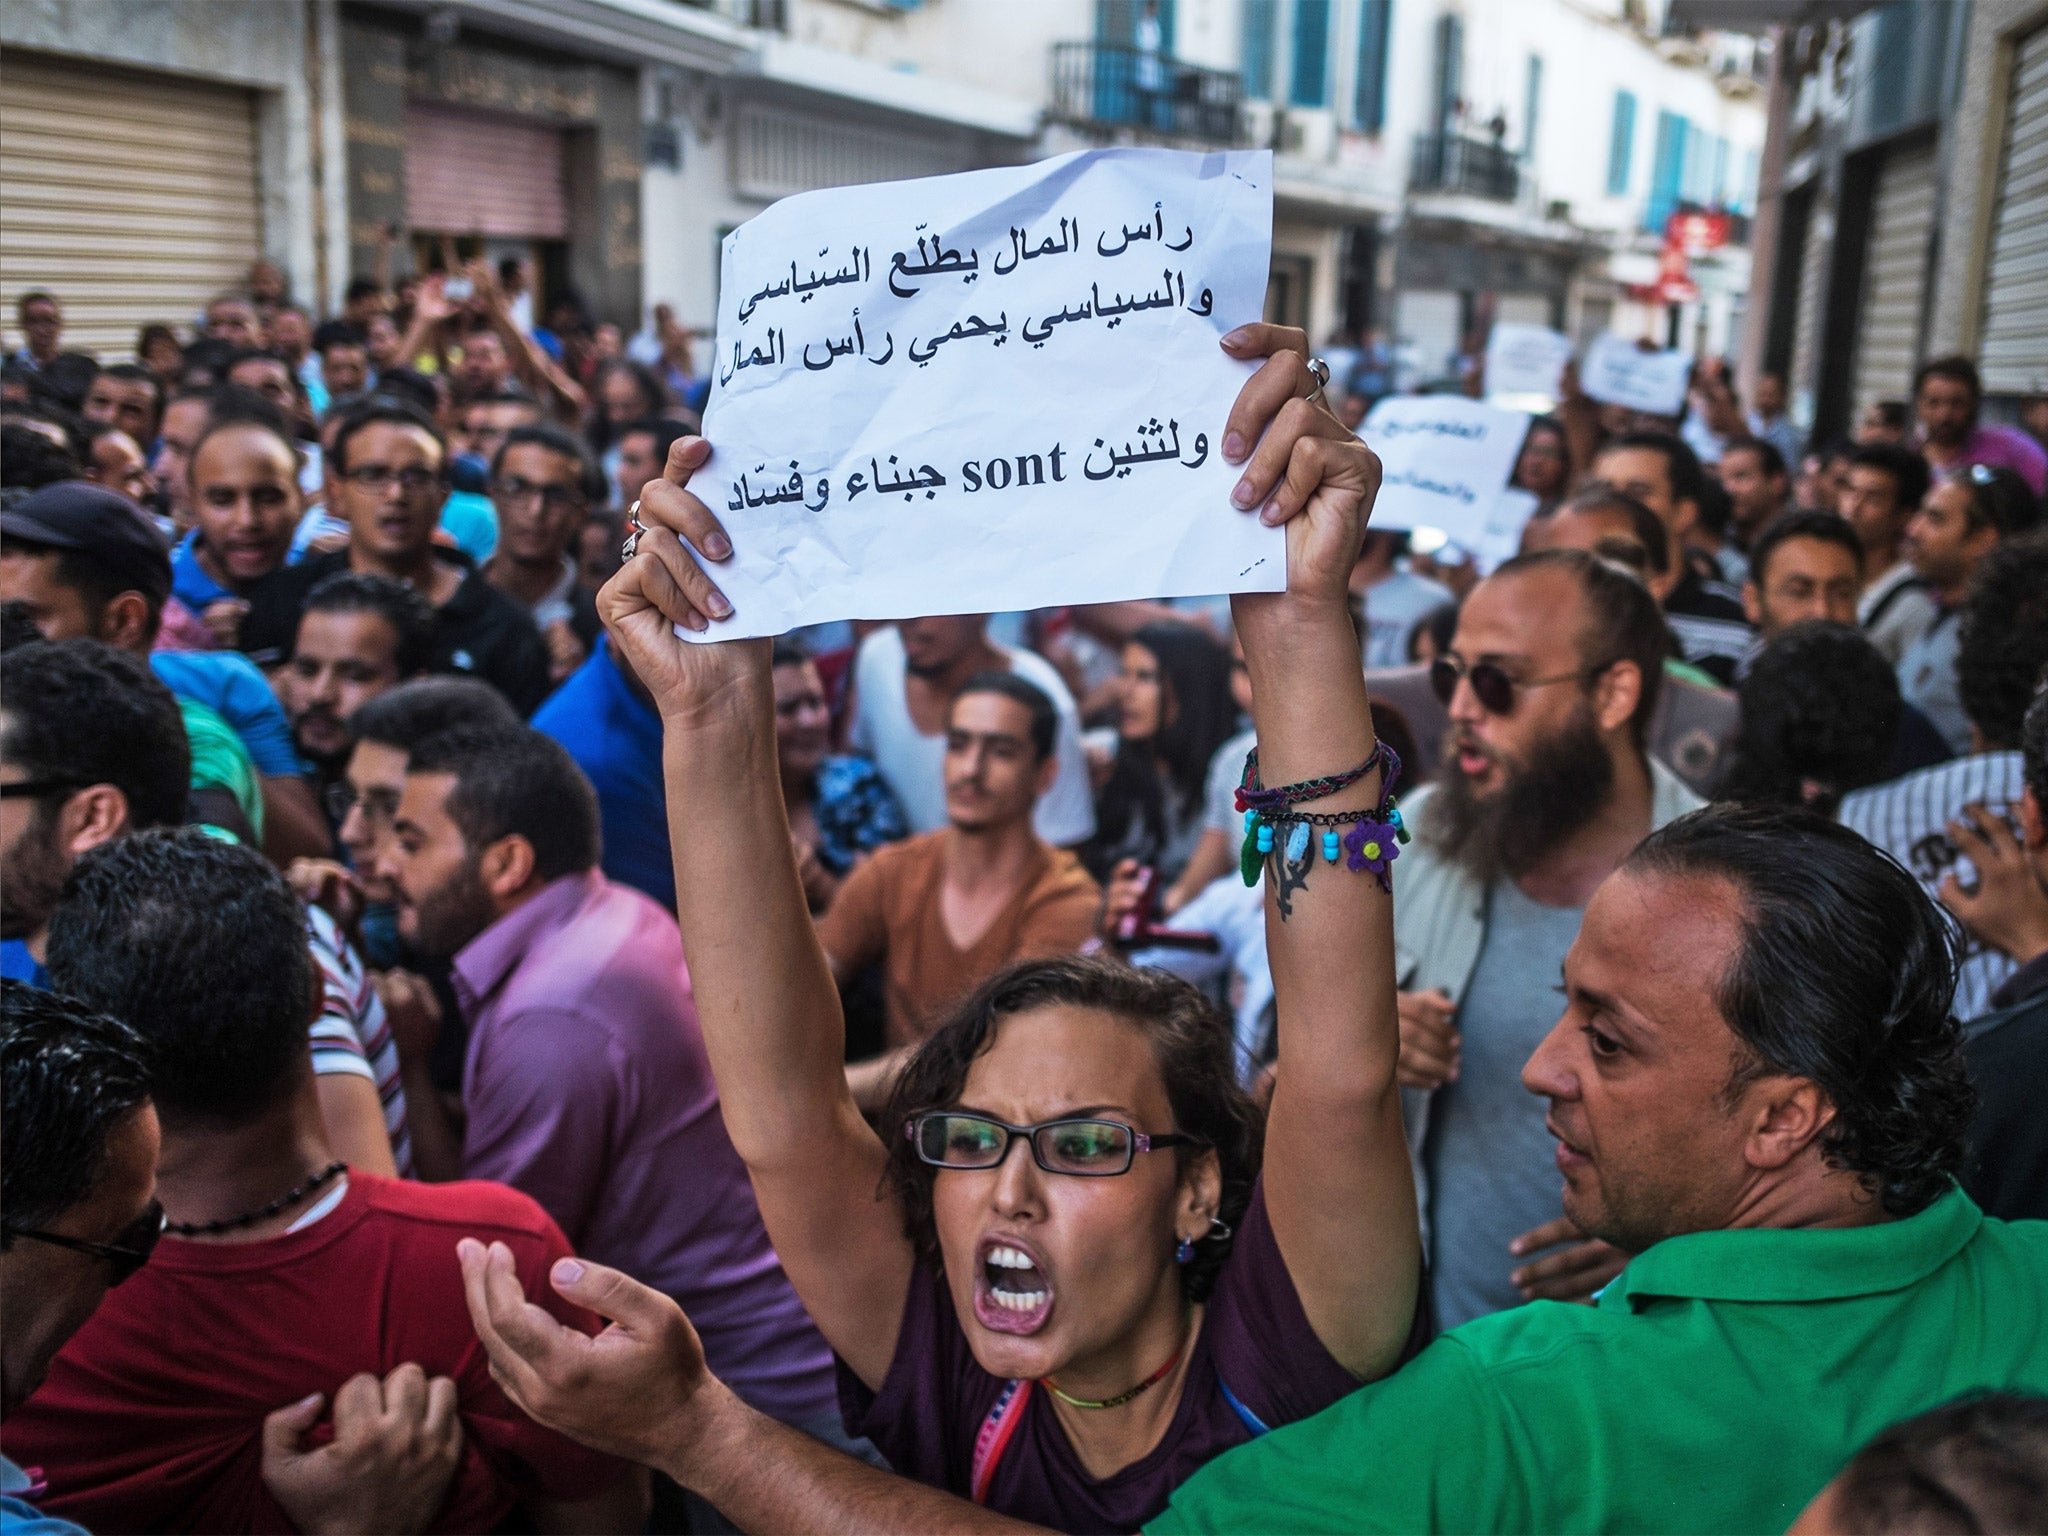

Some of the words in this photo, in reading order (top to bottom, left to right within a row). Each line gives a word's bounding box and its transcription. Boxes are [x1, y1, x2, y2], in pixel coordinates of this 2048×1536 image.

[993, 216, 1079, 276] المال
[1097, 201, 1193, 258] رأس
[802, 306, 894, 371] رأس
[1021, 269, 1214, 350] والسياسي
[720, 326, 786, 388] المال
[908, 311, 1008, 370] يحمي
[846, 454, 947, 503] جبناء
[962, 442, 1067, 493] sont
[1083, 417, 1209, 481] ولثنين
